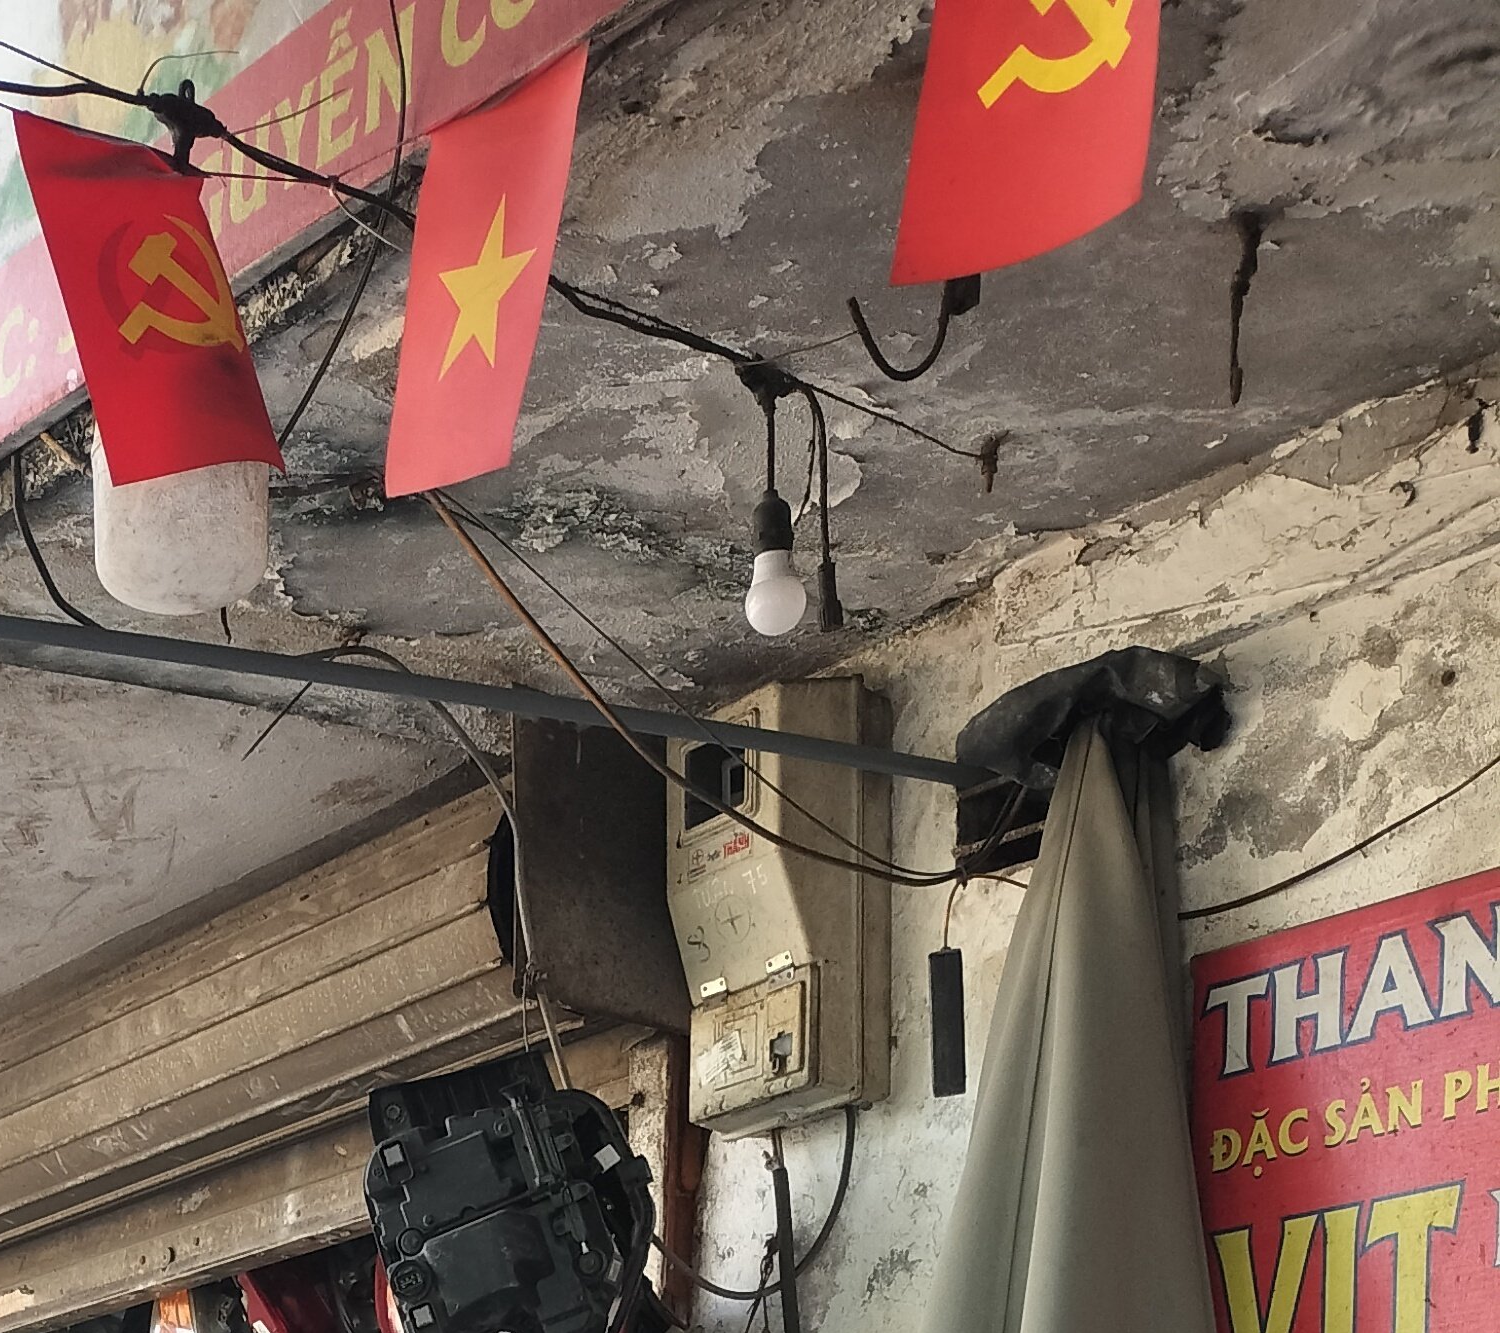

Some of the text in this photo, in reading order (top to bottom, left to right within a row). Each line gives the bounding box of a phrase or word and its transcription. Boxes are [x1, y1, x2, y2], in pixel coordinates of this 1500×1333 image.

[199, 6, 415, 242] GUYỄN
[1210, 1107, 1309, 1178] ĐẶC
[1323, 1077, 1424, 1149] SẢN
